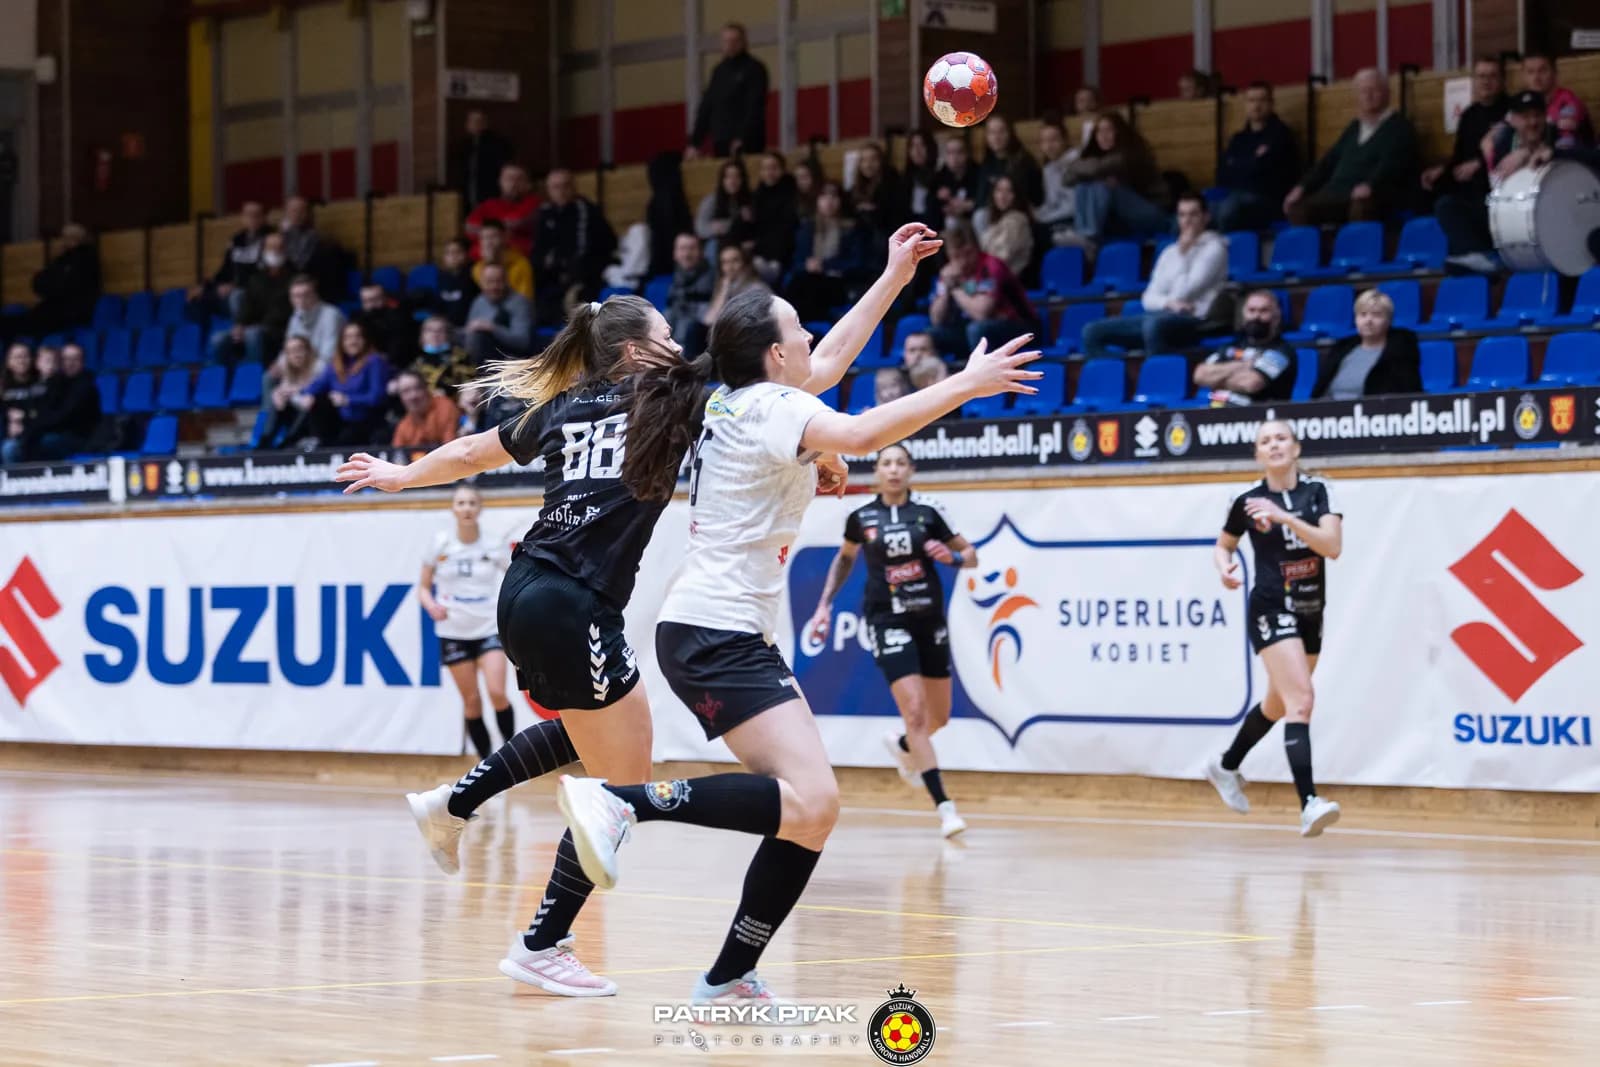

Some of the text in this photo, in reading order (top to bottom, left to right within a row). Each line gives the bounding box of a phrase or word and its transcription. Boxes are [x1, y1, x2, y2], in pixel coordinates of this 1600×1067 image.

[1198, 397, 1505, 446] wwworonahandball.pl
[561, 412, 628, 481] 88
[884, 531, 912, 558] 33
[1059, 599, 1227, 627] SUPERLIGA
[84, 584, 441, 687] SUZUKI
[1091, 643, 1189, 662] KOBIET
[1453, 713, 1592, 746] SUZUKI
